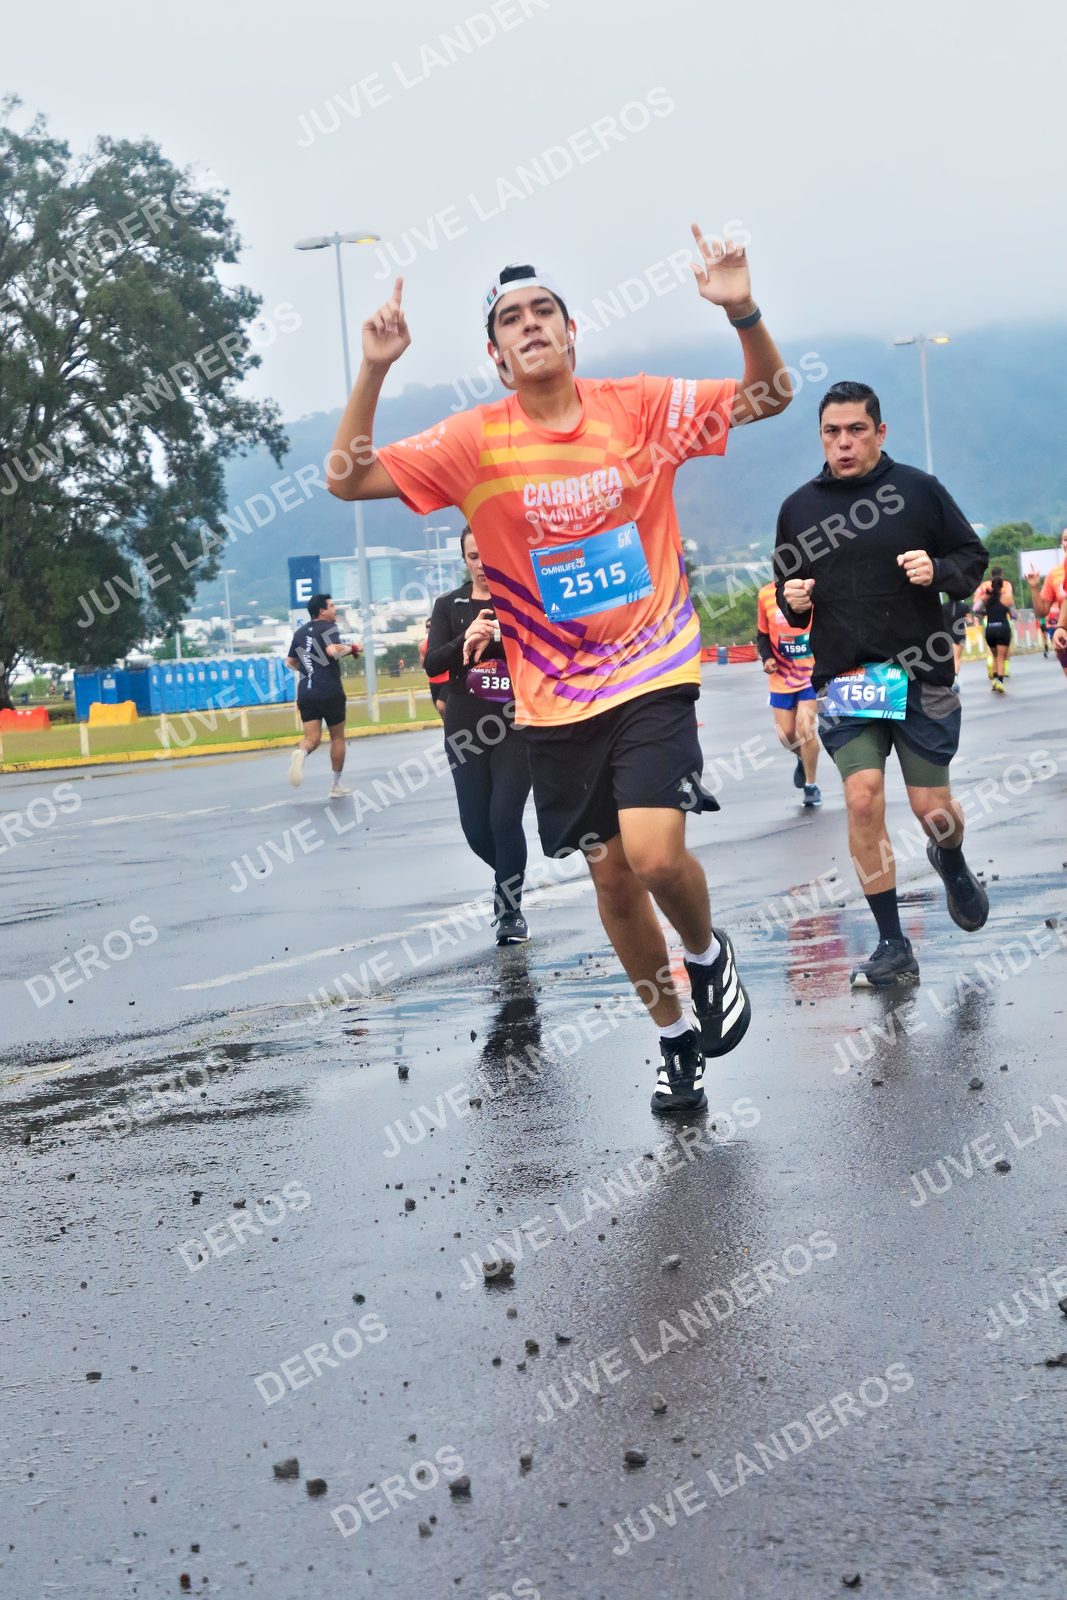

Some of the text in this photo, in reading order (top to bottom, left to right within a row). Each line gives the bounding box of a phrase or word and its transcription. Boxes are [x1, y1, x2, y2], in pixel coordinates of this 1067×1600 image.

[523, 466, 623, 507] CARRERA
[295, 578, 312, 602] E
[559, 561, 627, 599] 2515
[784, 644, 807, 654] 1596
[481, 675, 510, 690] 338
[841, 684, 886, 702] 1561
